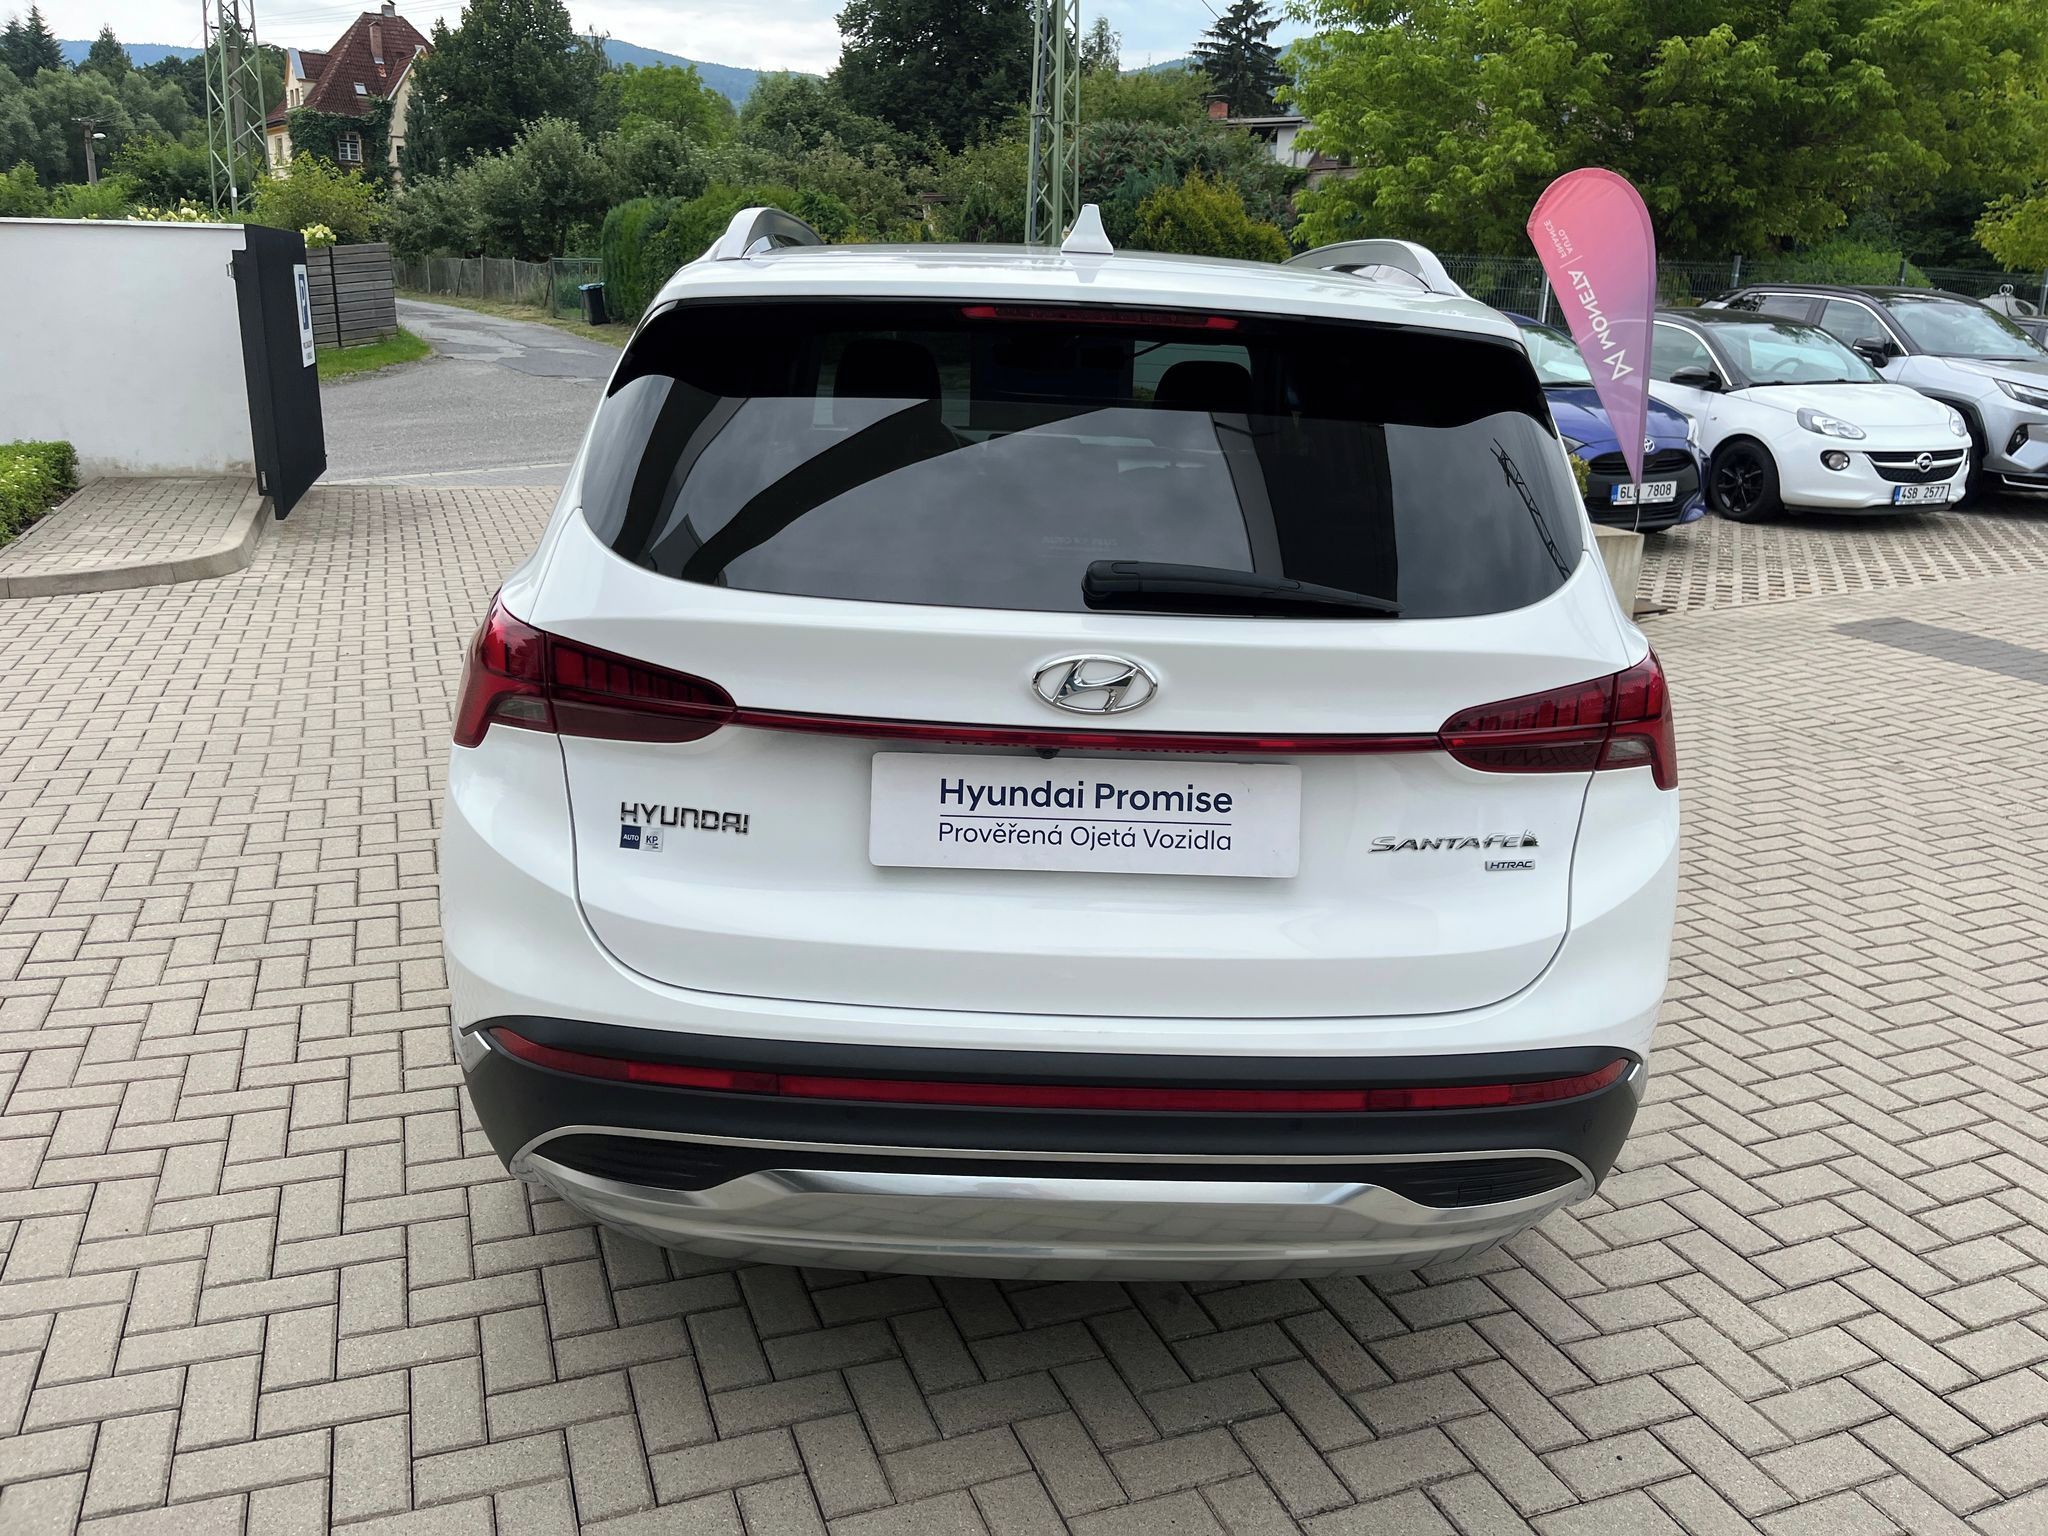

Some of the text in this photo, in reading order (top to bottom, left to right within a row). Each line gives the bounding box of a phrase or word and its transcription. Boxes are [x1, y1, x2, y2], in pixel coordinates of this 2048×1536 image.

[1647, 483, 1672, 498] 7808
[1901, 486, 1946, 499] 4SB 2577
[939, 778, 1233, 813] Hyundai Promise
[620, 801, 750, 834] HYUNDAI
[622, 833, 659, 844] AUTO KP
[939, 822, 1232, 851] Prověřená Ojetá Vozidla
[1367, 835, 1481, 854] SANTA
[1489, 860, 1533, 869] HTRAC
